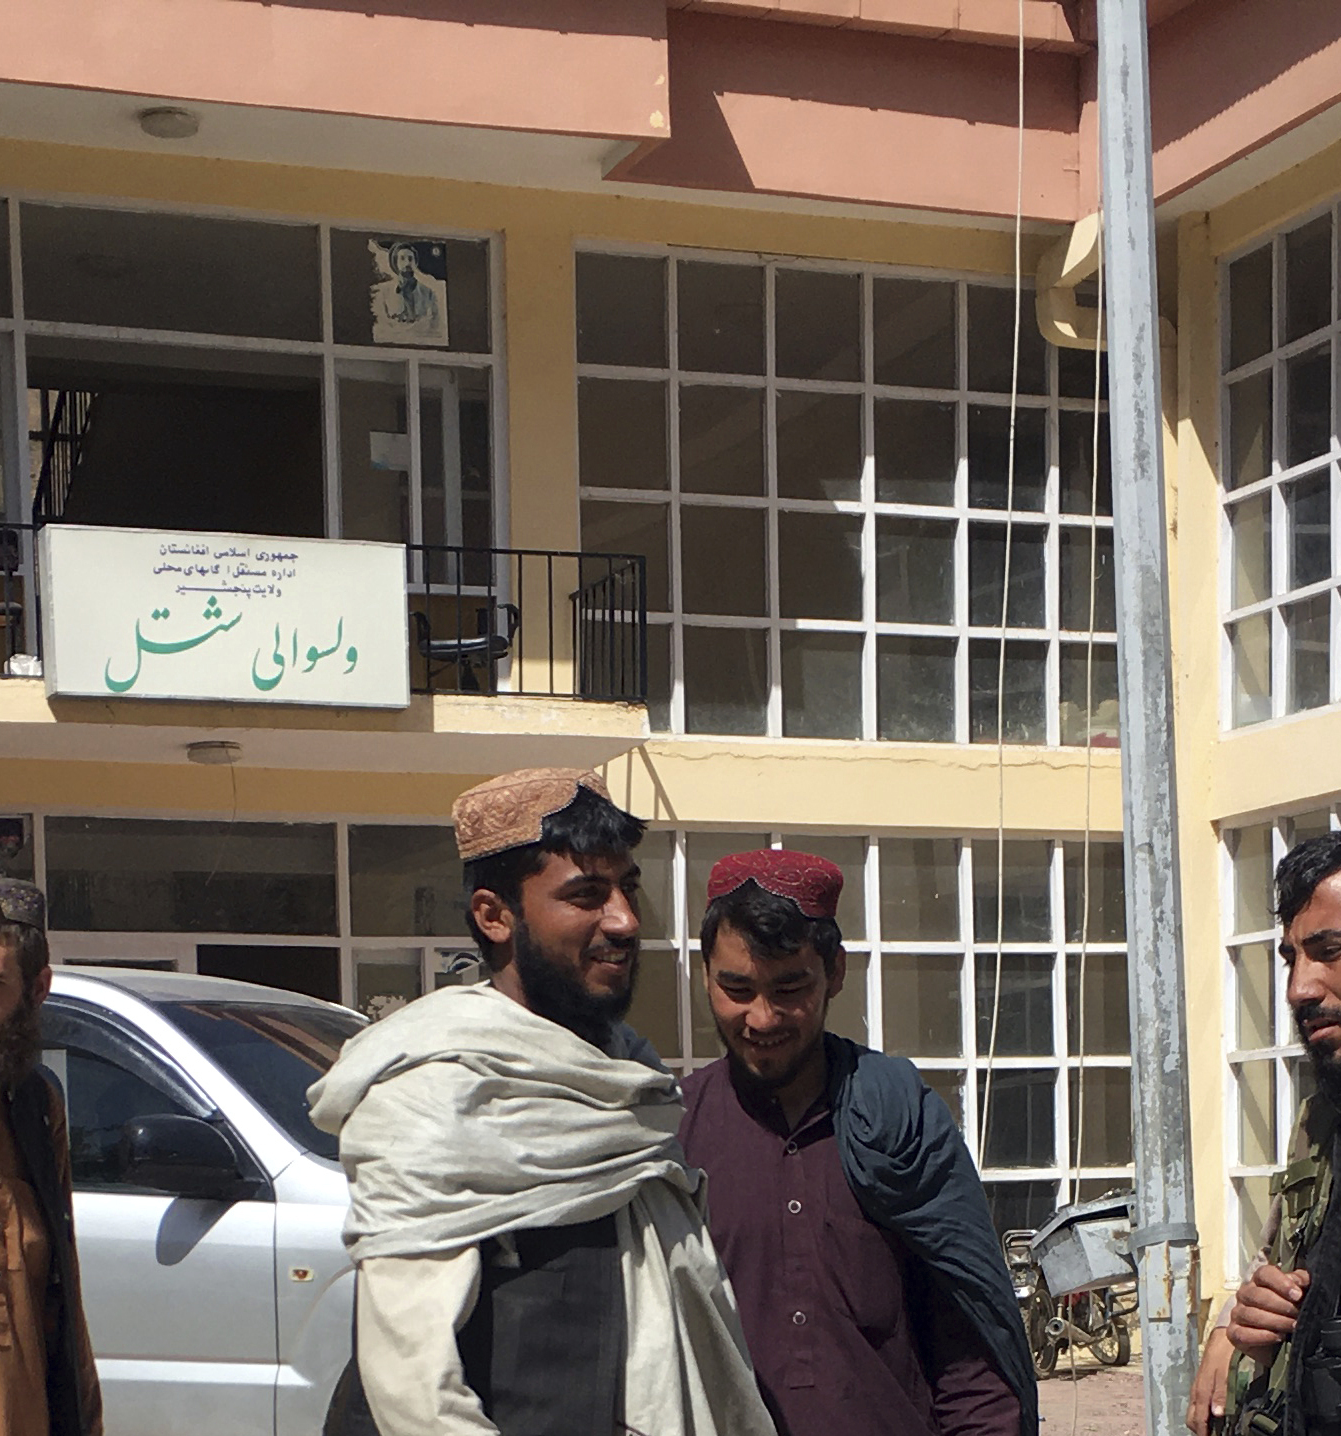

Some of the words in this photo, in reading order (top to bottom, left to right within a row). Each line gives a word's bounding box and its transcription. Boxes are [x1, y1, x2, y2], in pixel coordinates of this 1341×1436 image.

[159, 543, 210, 556] افغانستان
[213, 546, 250, 560] اسلامی
[256, 551, 299, 563] جمهوری
[153, 562, 182, 574] محلی
[232, 562, 267, 578] مستقل
[271, 568, 296, 581] اداره
[175, 579, 251, 599] پنجشیر
[252, 584, 282, 598] ولایت
[104, 595, 243, 692] شتل
[251, 615, 358, 691] ولسوالی
